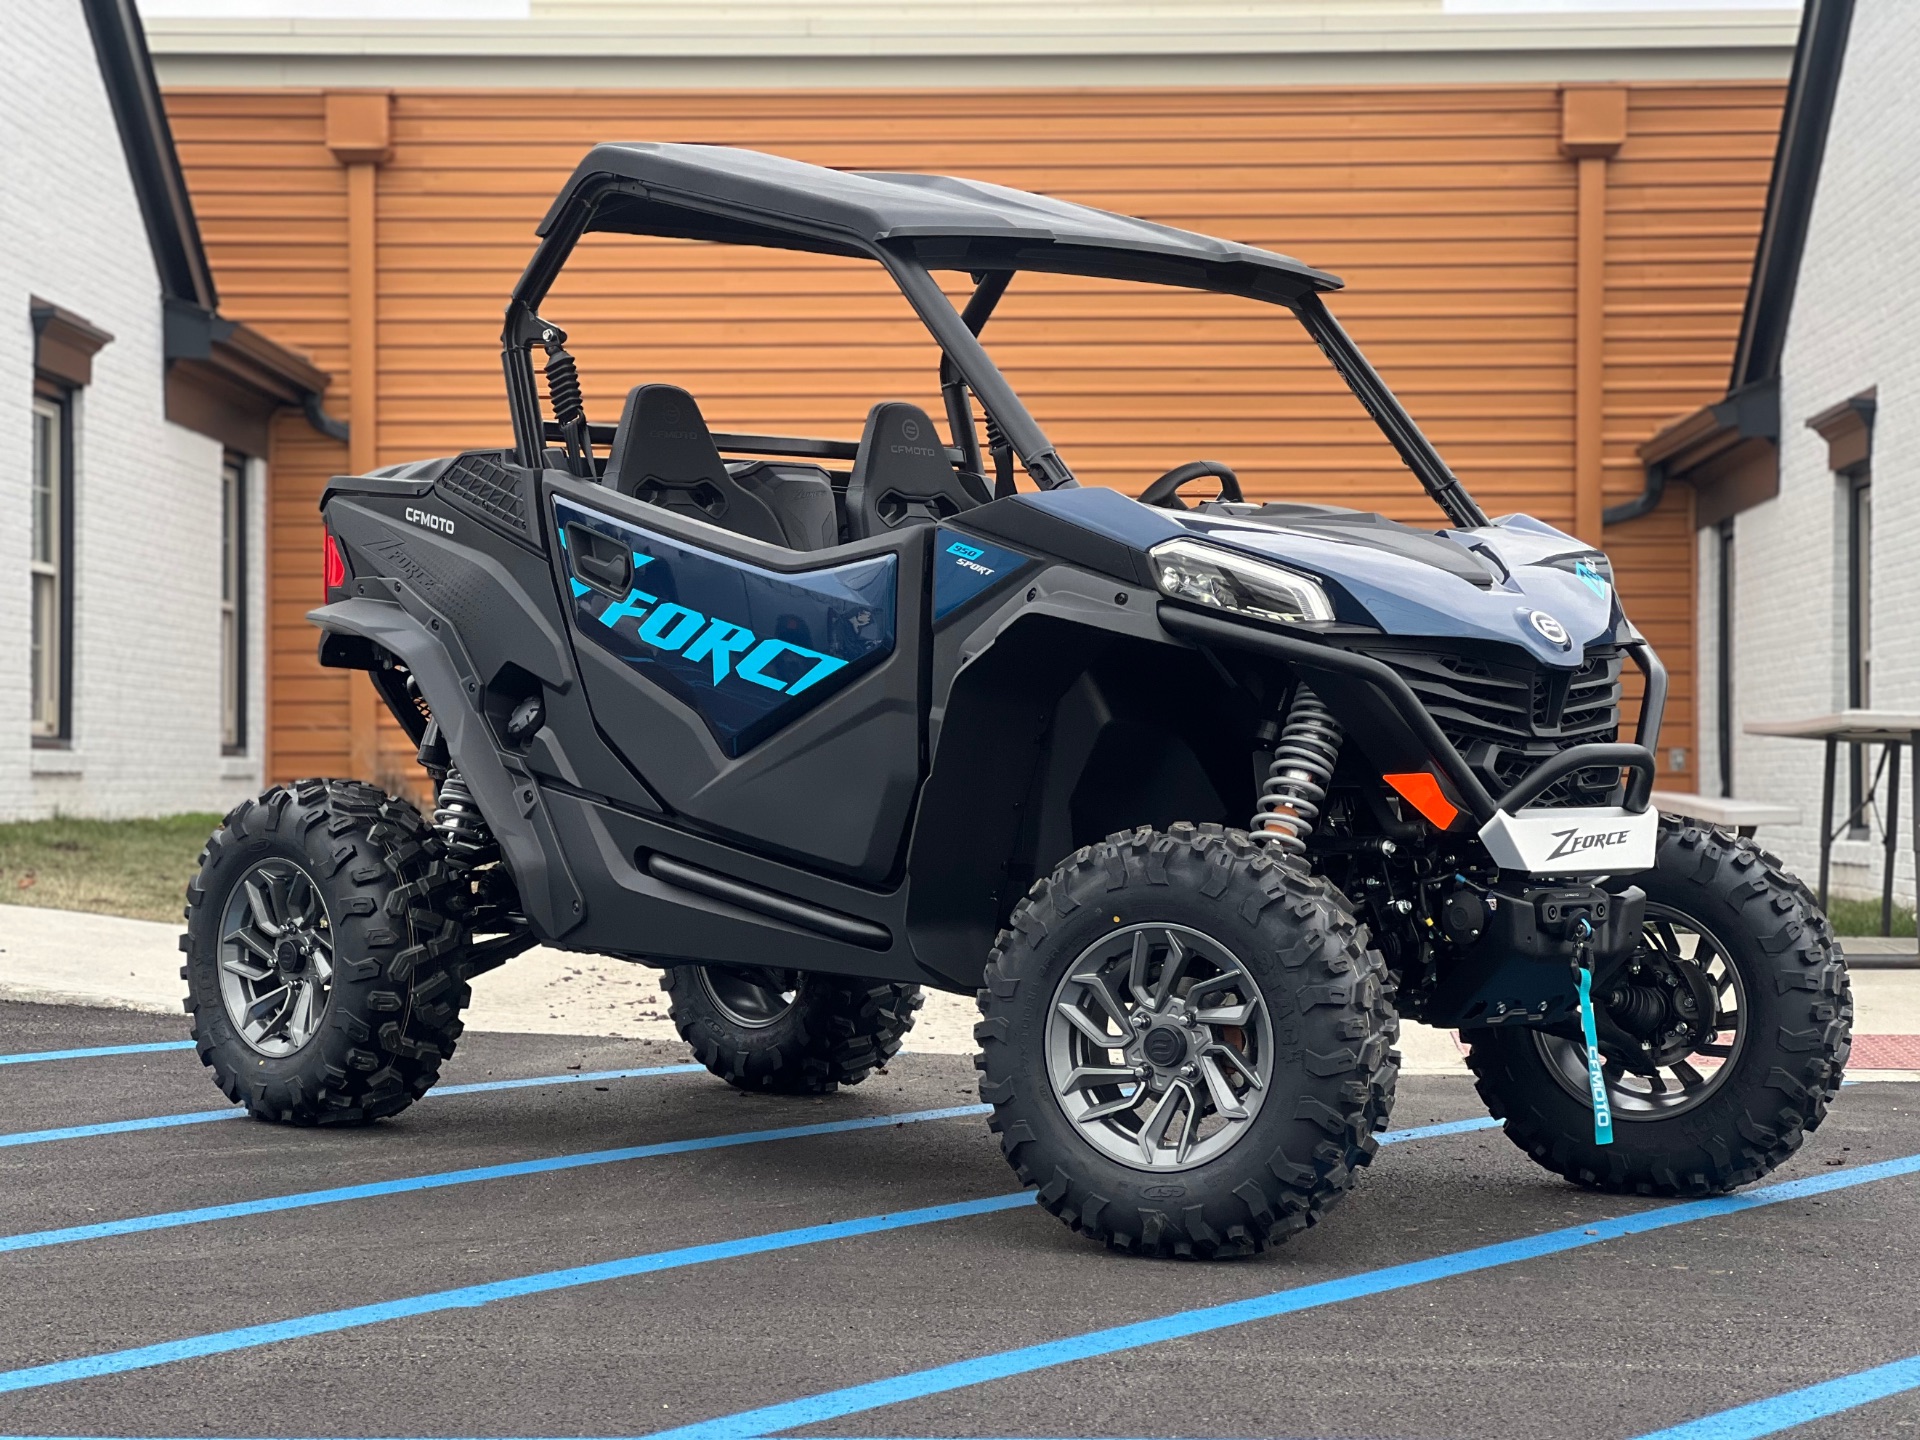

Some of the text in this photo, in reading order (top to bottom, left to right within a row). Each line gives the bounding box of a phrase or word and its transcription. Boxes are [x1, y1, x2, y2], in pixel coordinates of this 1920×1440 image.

[890, 444, 935, 457] CFMOTO
[405, 507, 455, 535] CFMOTO
[953, 545, 977, 557] 950
[955, 558, 995, 575] SPORT
[1545, 827, 1632, 862] ZFORCE
[1588, 1045, 1610, 1127] CFMOTO
